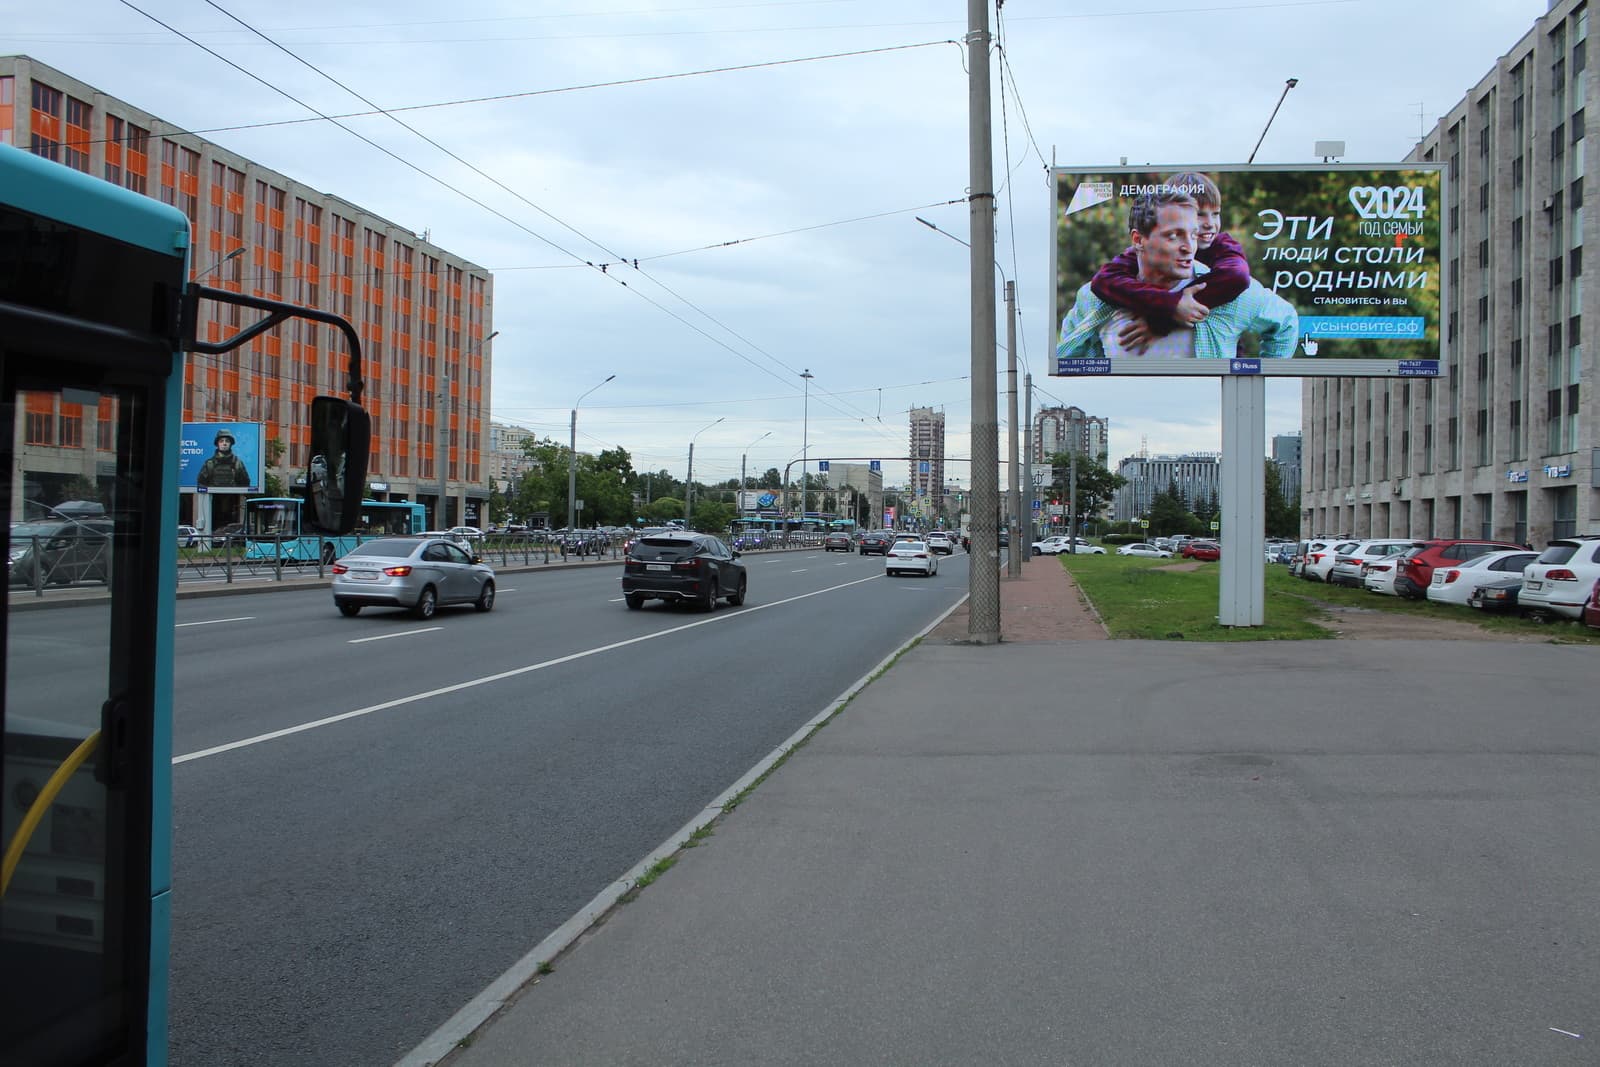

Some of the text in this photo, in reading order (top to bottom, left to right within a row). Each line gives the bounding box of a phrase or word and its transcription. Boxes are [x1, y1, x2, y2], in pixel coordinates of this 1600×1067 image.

[1119, 184, 1205, 196] ДЕМОГРАФИЯ
[1355, 186, 1426, 219] 2024
[1253, 209, 1335, 241] Эти
[1263, 247, 1425, 264] люди стали
[1273, 271, 1428, 294] родными
[1313, 297, 1408, 306] СТАНОВИТЕСЬ И ВЫ
[1312, 320, 1419, 333] усыновите.рф
